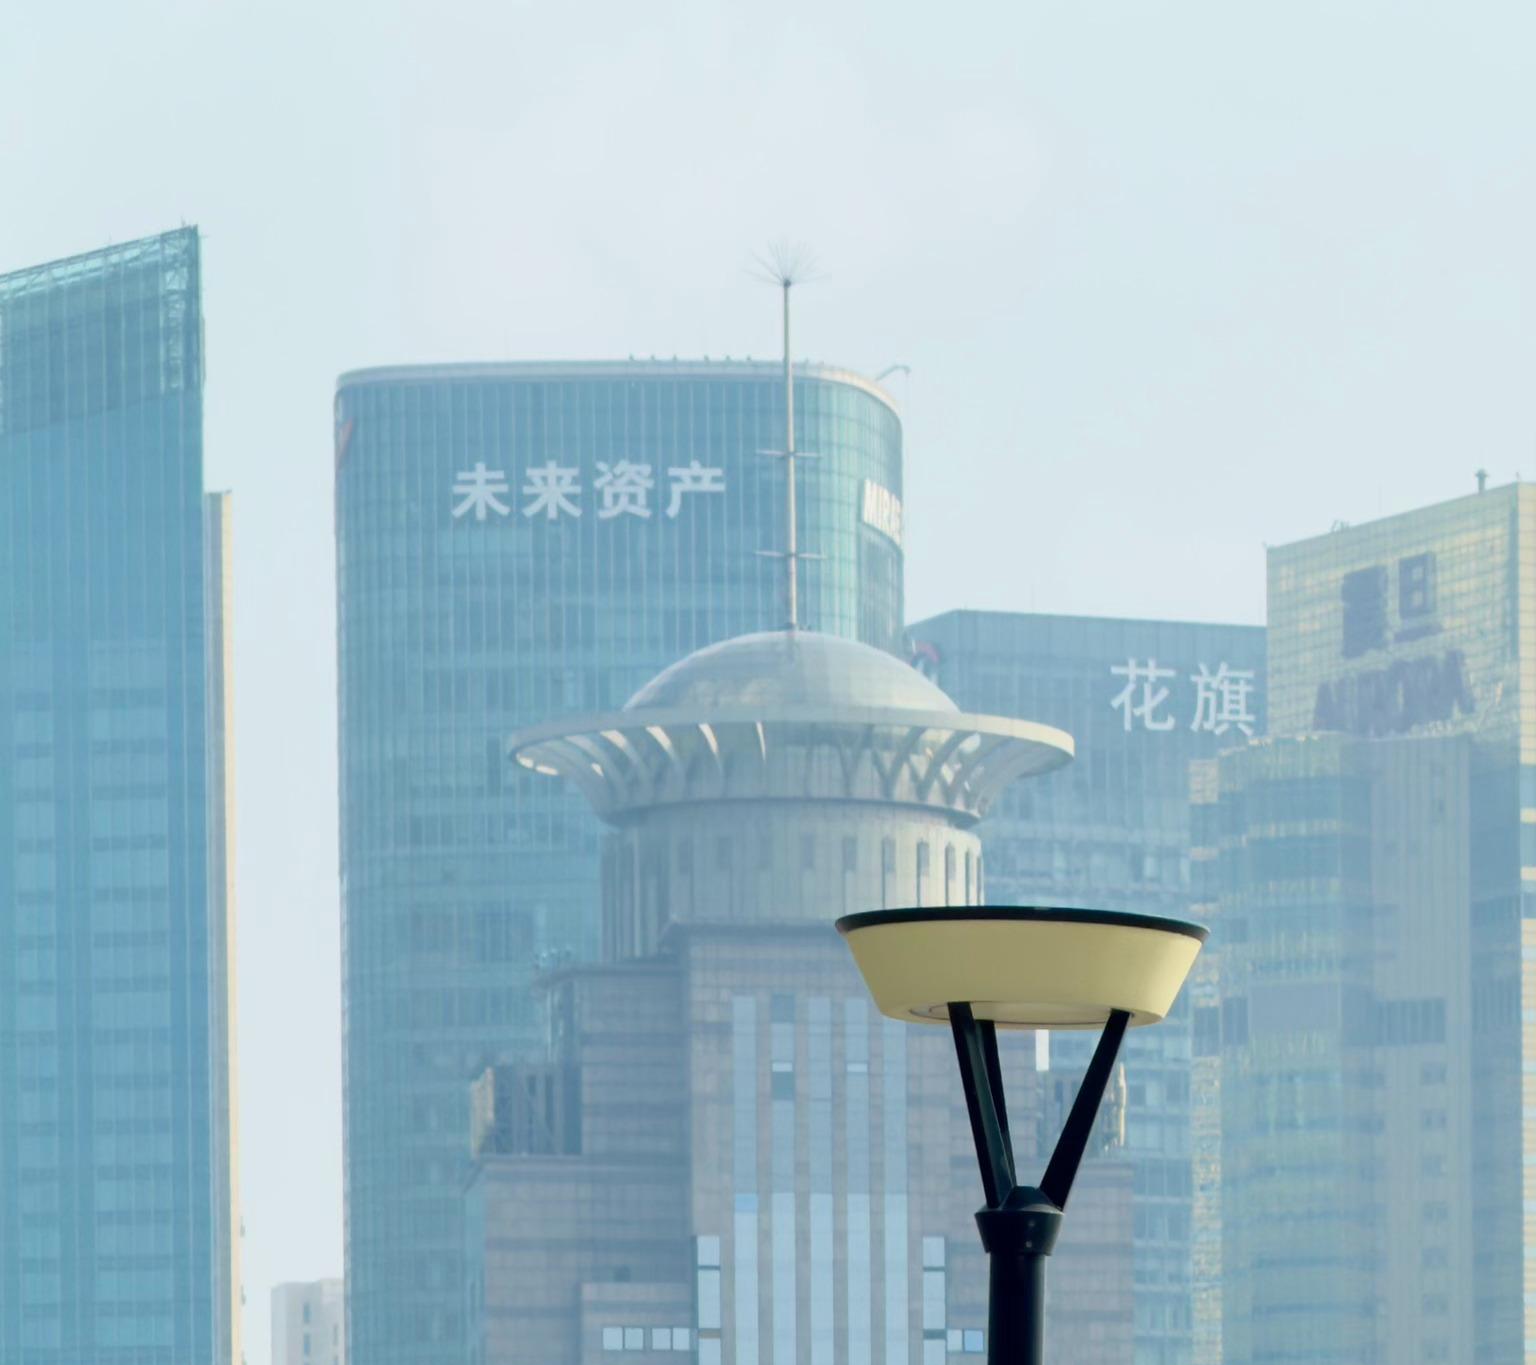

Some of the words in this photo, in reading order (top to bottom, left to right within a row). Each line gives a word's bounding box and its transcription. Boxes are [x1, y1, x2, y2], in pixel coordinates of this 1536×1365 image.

[452, 461, 725, 519] 未来资产
[1110, 658, 1256, 737] 花旗
